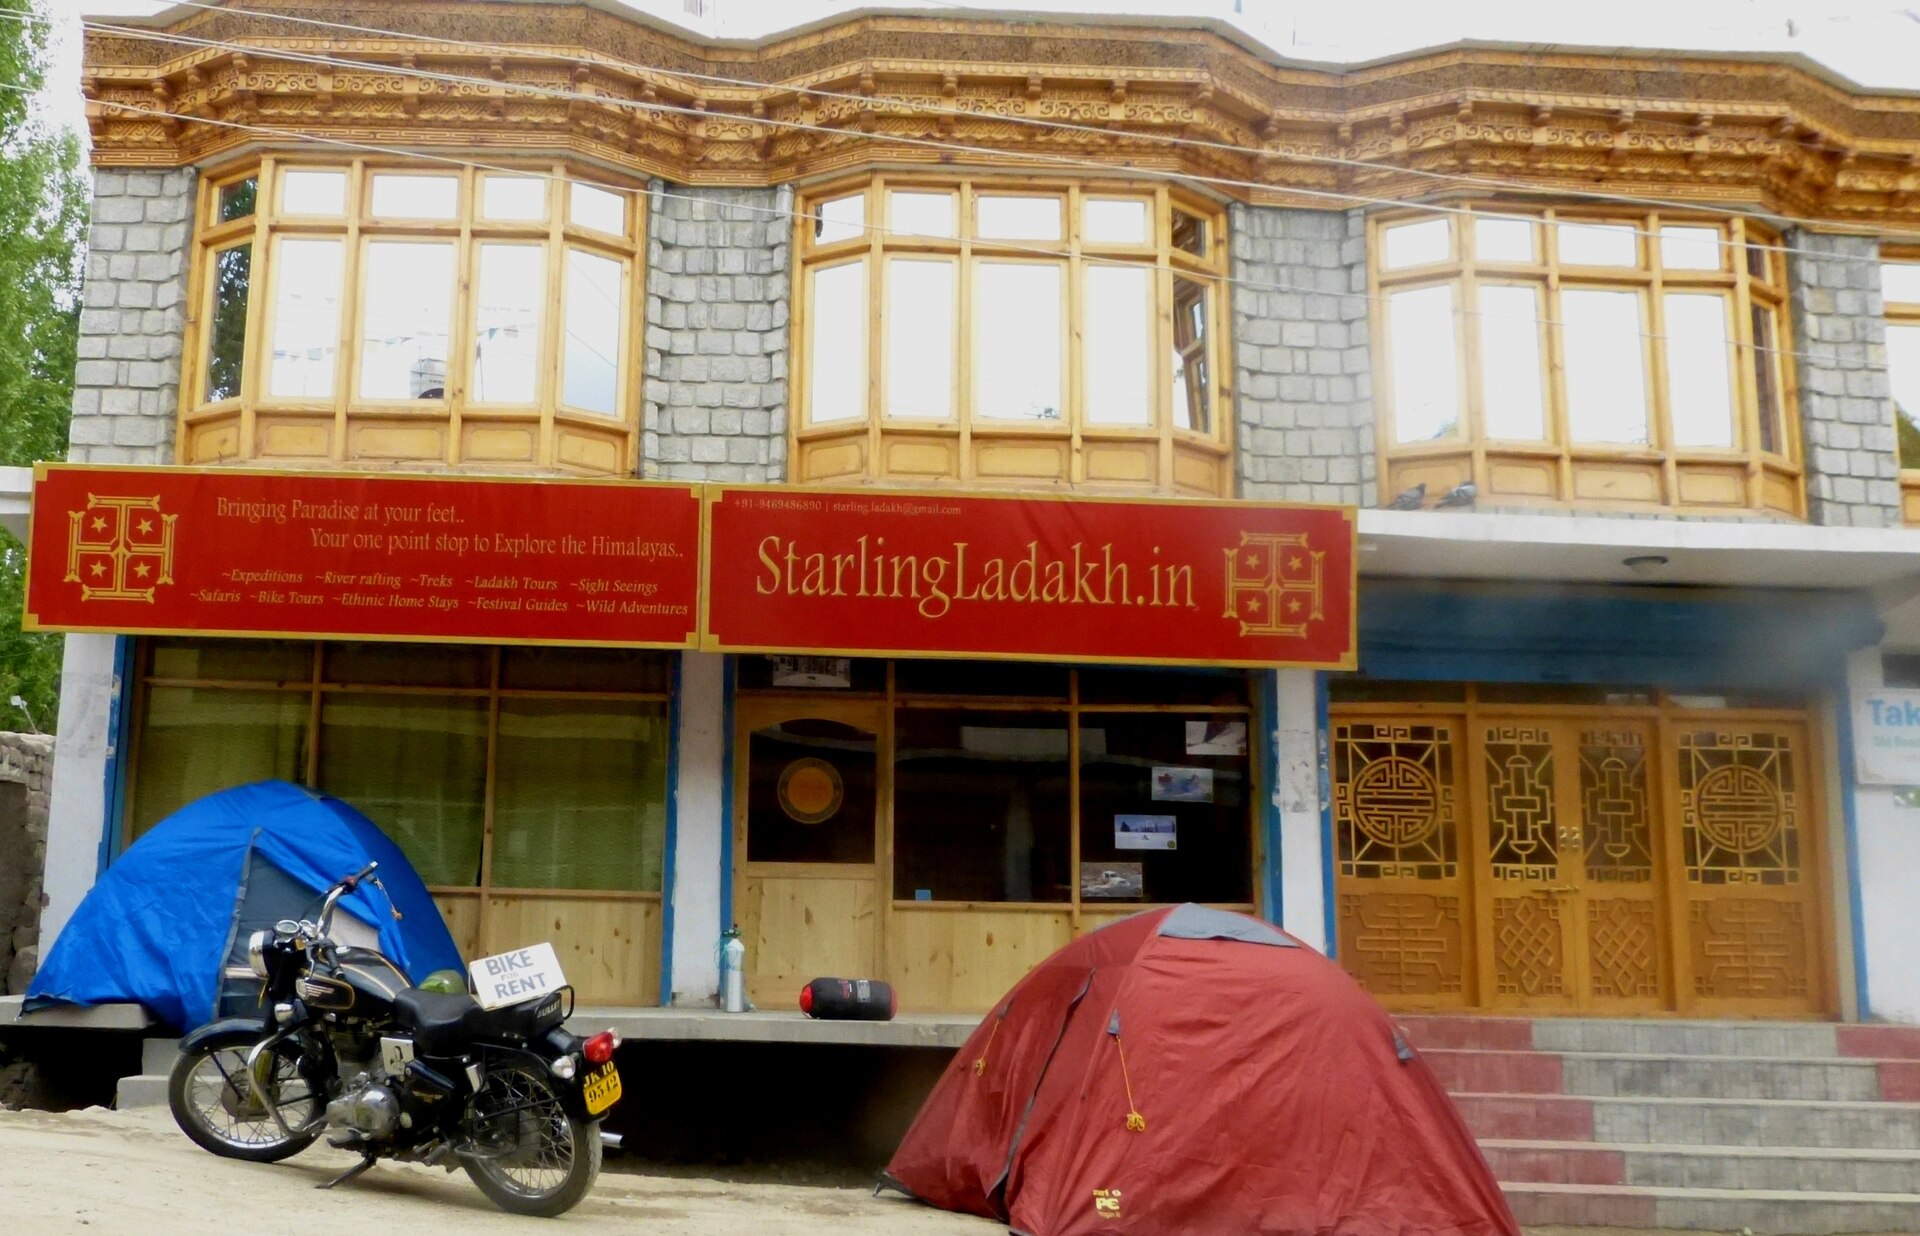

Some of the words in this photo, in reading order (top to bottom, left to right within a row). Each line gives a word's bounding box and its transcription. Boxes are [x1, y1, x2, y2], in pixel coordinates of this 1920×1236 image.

[217, 497, 287, 524] Bringing
[292, 499, 359, 521] Paradise
[364, 503, 379, 521] at
[384, 506, 421, 526] your
[833, 501, 962, 517] starling.ladakh@gmail.com
[311, 527, 349, 549] Your
[353, 532, 383, 549] one
[388, 530, 430, 555] point
[436, 532, 469, 556] stop
[474, 534, 489, 552] to
[494, 533, 556, 558] Explore
[561, 535, 587, 555] the
[359, 573, 402, 589] rafting
[523, 577, 558, 590] Tours
[613, 580, 659, 596] Seeings
[756, 534, 1197, 619] StarlingLadakh.in
[289, 591, 324, 605] Tours
[389, 593, 425, 608] Home
[428, 594, 459, 611] Stays
[525, 598, 568, 612] Guides
[619, 601, 689, 616] Adventures
[485, 950, 533, 976] BIKE
[501, 971, 519, 981] FOR
[494, 972, 546, 999] RENT
